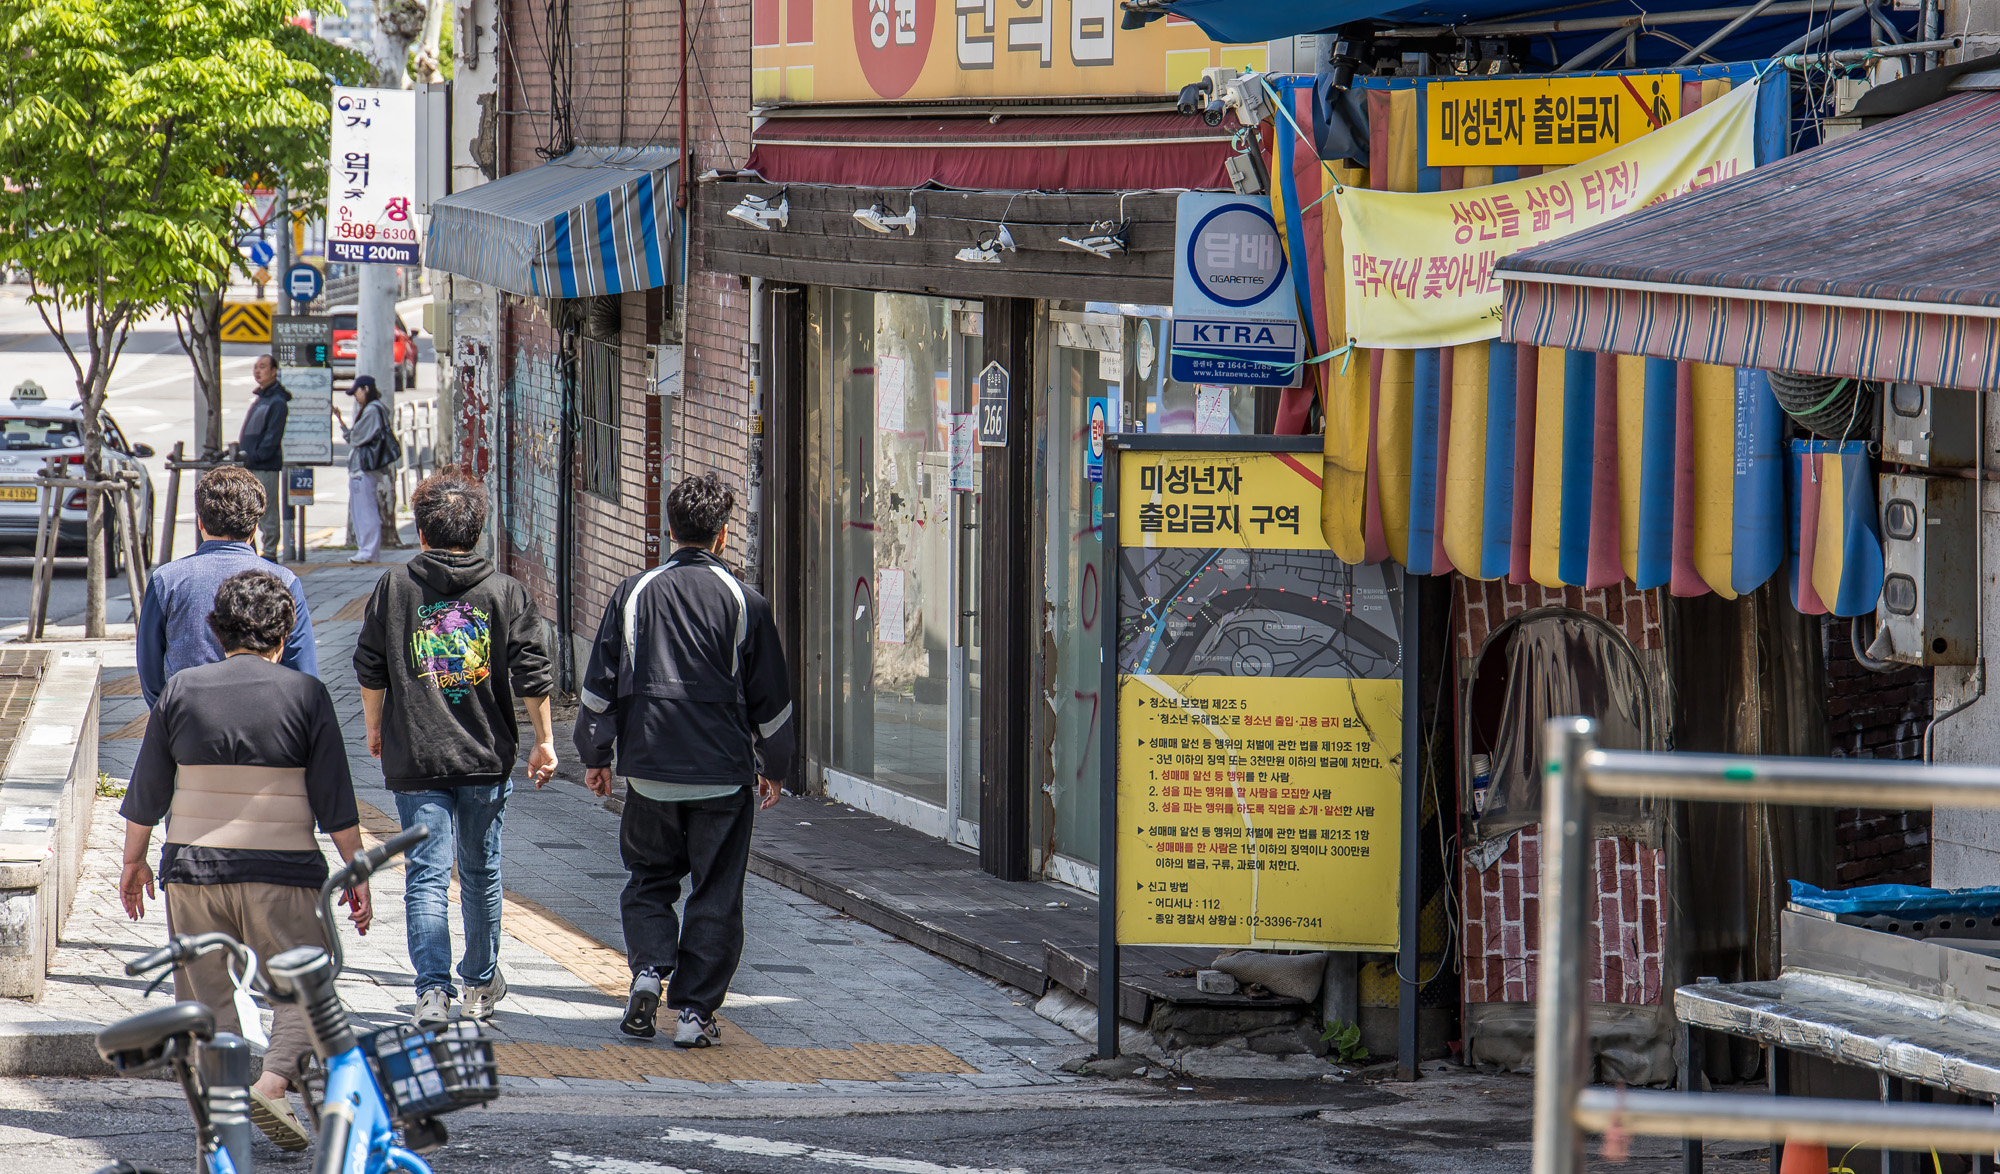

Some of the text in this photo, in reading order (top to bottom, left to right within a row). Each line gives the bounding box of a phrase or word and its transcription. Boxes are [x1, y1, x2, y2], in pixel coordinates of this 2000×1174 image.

[1441, 94, 1620, 147] 미성년자 출입금지
[1449, 194, 1520, 245] 상인들
[1527, 180, 1575, 233] 삶의
[1583, 160, 1639, 215] 터전!
[368, 245, 410, 261] 200m
[1204, 232, 1274, 270] 담배
[1209, 274, 1264, 285] CIGARETTES
[1351, 251, 1423, 300] 막무가내
[1193, 324, 1275, 345] KTRA
[1193, 369, 1270, 378] www.ktranews.co.kr
[17, 387, 37, 396] TAXI
[983, 404, 1002, 436] 266
[1139, 464, 1243, 495] 미성년자
[1138, 502, 1300, 535] 출입금지 구역
[1149, 697, 1247, 709] 청소년 보호법 제2조 5
[1243, 715, 1271, 727] 청소년
[1321, 717, 1339, 728] 금지
[1342, 717, 1362, 728] 업소
[1149, 737, 1371, 752] 성매매 알선 등 행위의 처벌에 관한 법률 제19조 1항
[1156, 753, 1383, 769] 3년 이하의 징역 또는 3천만원 이하의 벌금에 처한다.
[1149, 770, 1290, 783] 1. 성매매 알선 등 행위를 한 사람
[1148, 785, 1331, 800] 2. 성을 파는 행위를 할 사람을 모집한 사람
[1148, 801, 1158, 812] 3.
[1161, 801, 1180, 813] 성을
[1183, 802, 1202, 813] 파는
[1205, 802, 1233, 814] 행위를
[1236, 803, 1265, 815] 하도록
[1268, 803, 1295, 815] 직업을
[1355, 806, 1375, 817] 사람
[1148, 826, 1370, 841] 성매매 알선 등 행위의 처벌에 관한 법률 제21조 1항
[1156, 841, 1370, 857] 성매매를 한 사람은 1년 이하의 징역이나 300만원
[1155, 857, 1300, 871] 이하의 벌금, 구류, 과료에 처한다.
[1148, 881, 1188, 893] 신고 방법
[1155, 897, 1220, 909] 어디서나 112
[1155, 913, 1322, 928] 종암 경찰서 상황실 02-3396-7341
